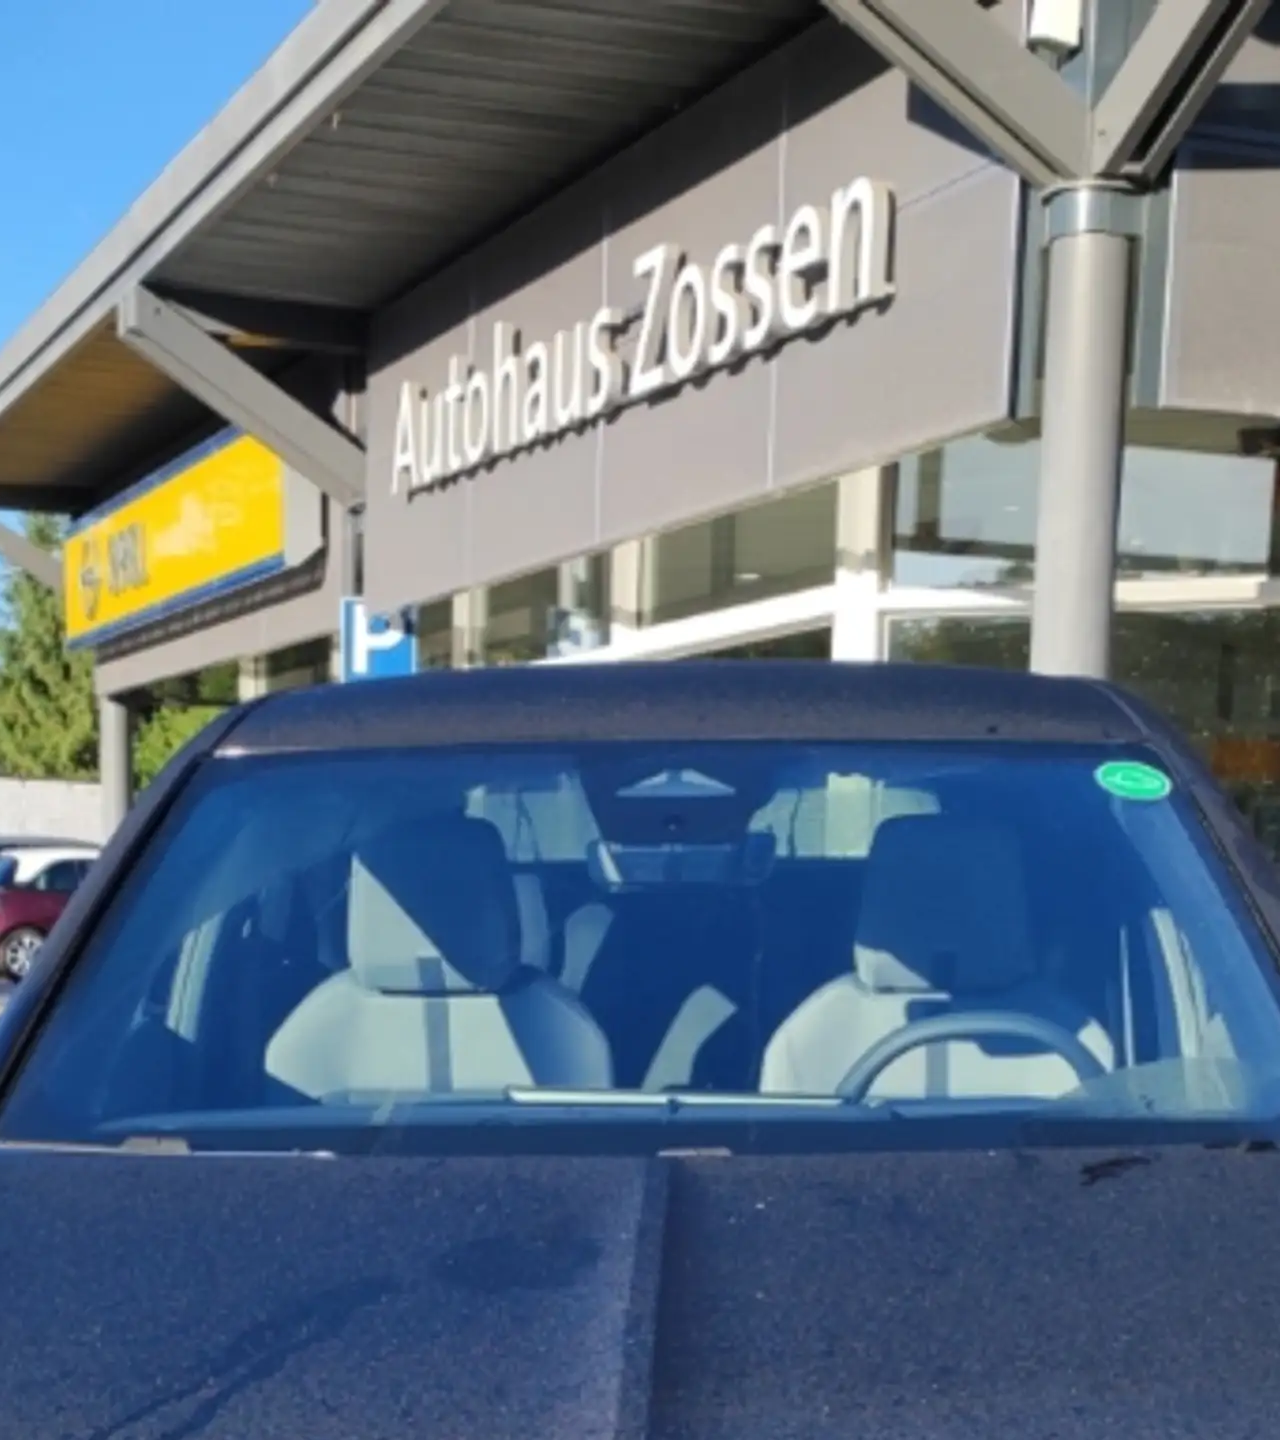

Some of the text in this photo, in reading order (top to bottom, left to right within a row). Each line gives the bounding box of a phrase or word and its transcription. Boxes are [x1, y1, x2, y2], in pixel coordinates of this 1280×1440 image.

[391, 175, 892, 496] Autohaus Zossen
[352, 603, 405, 673] P
